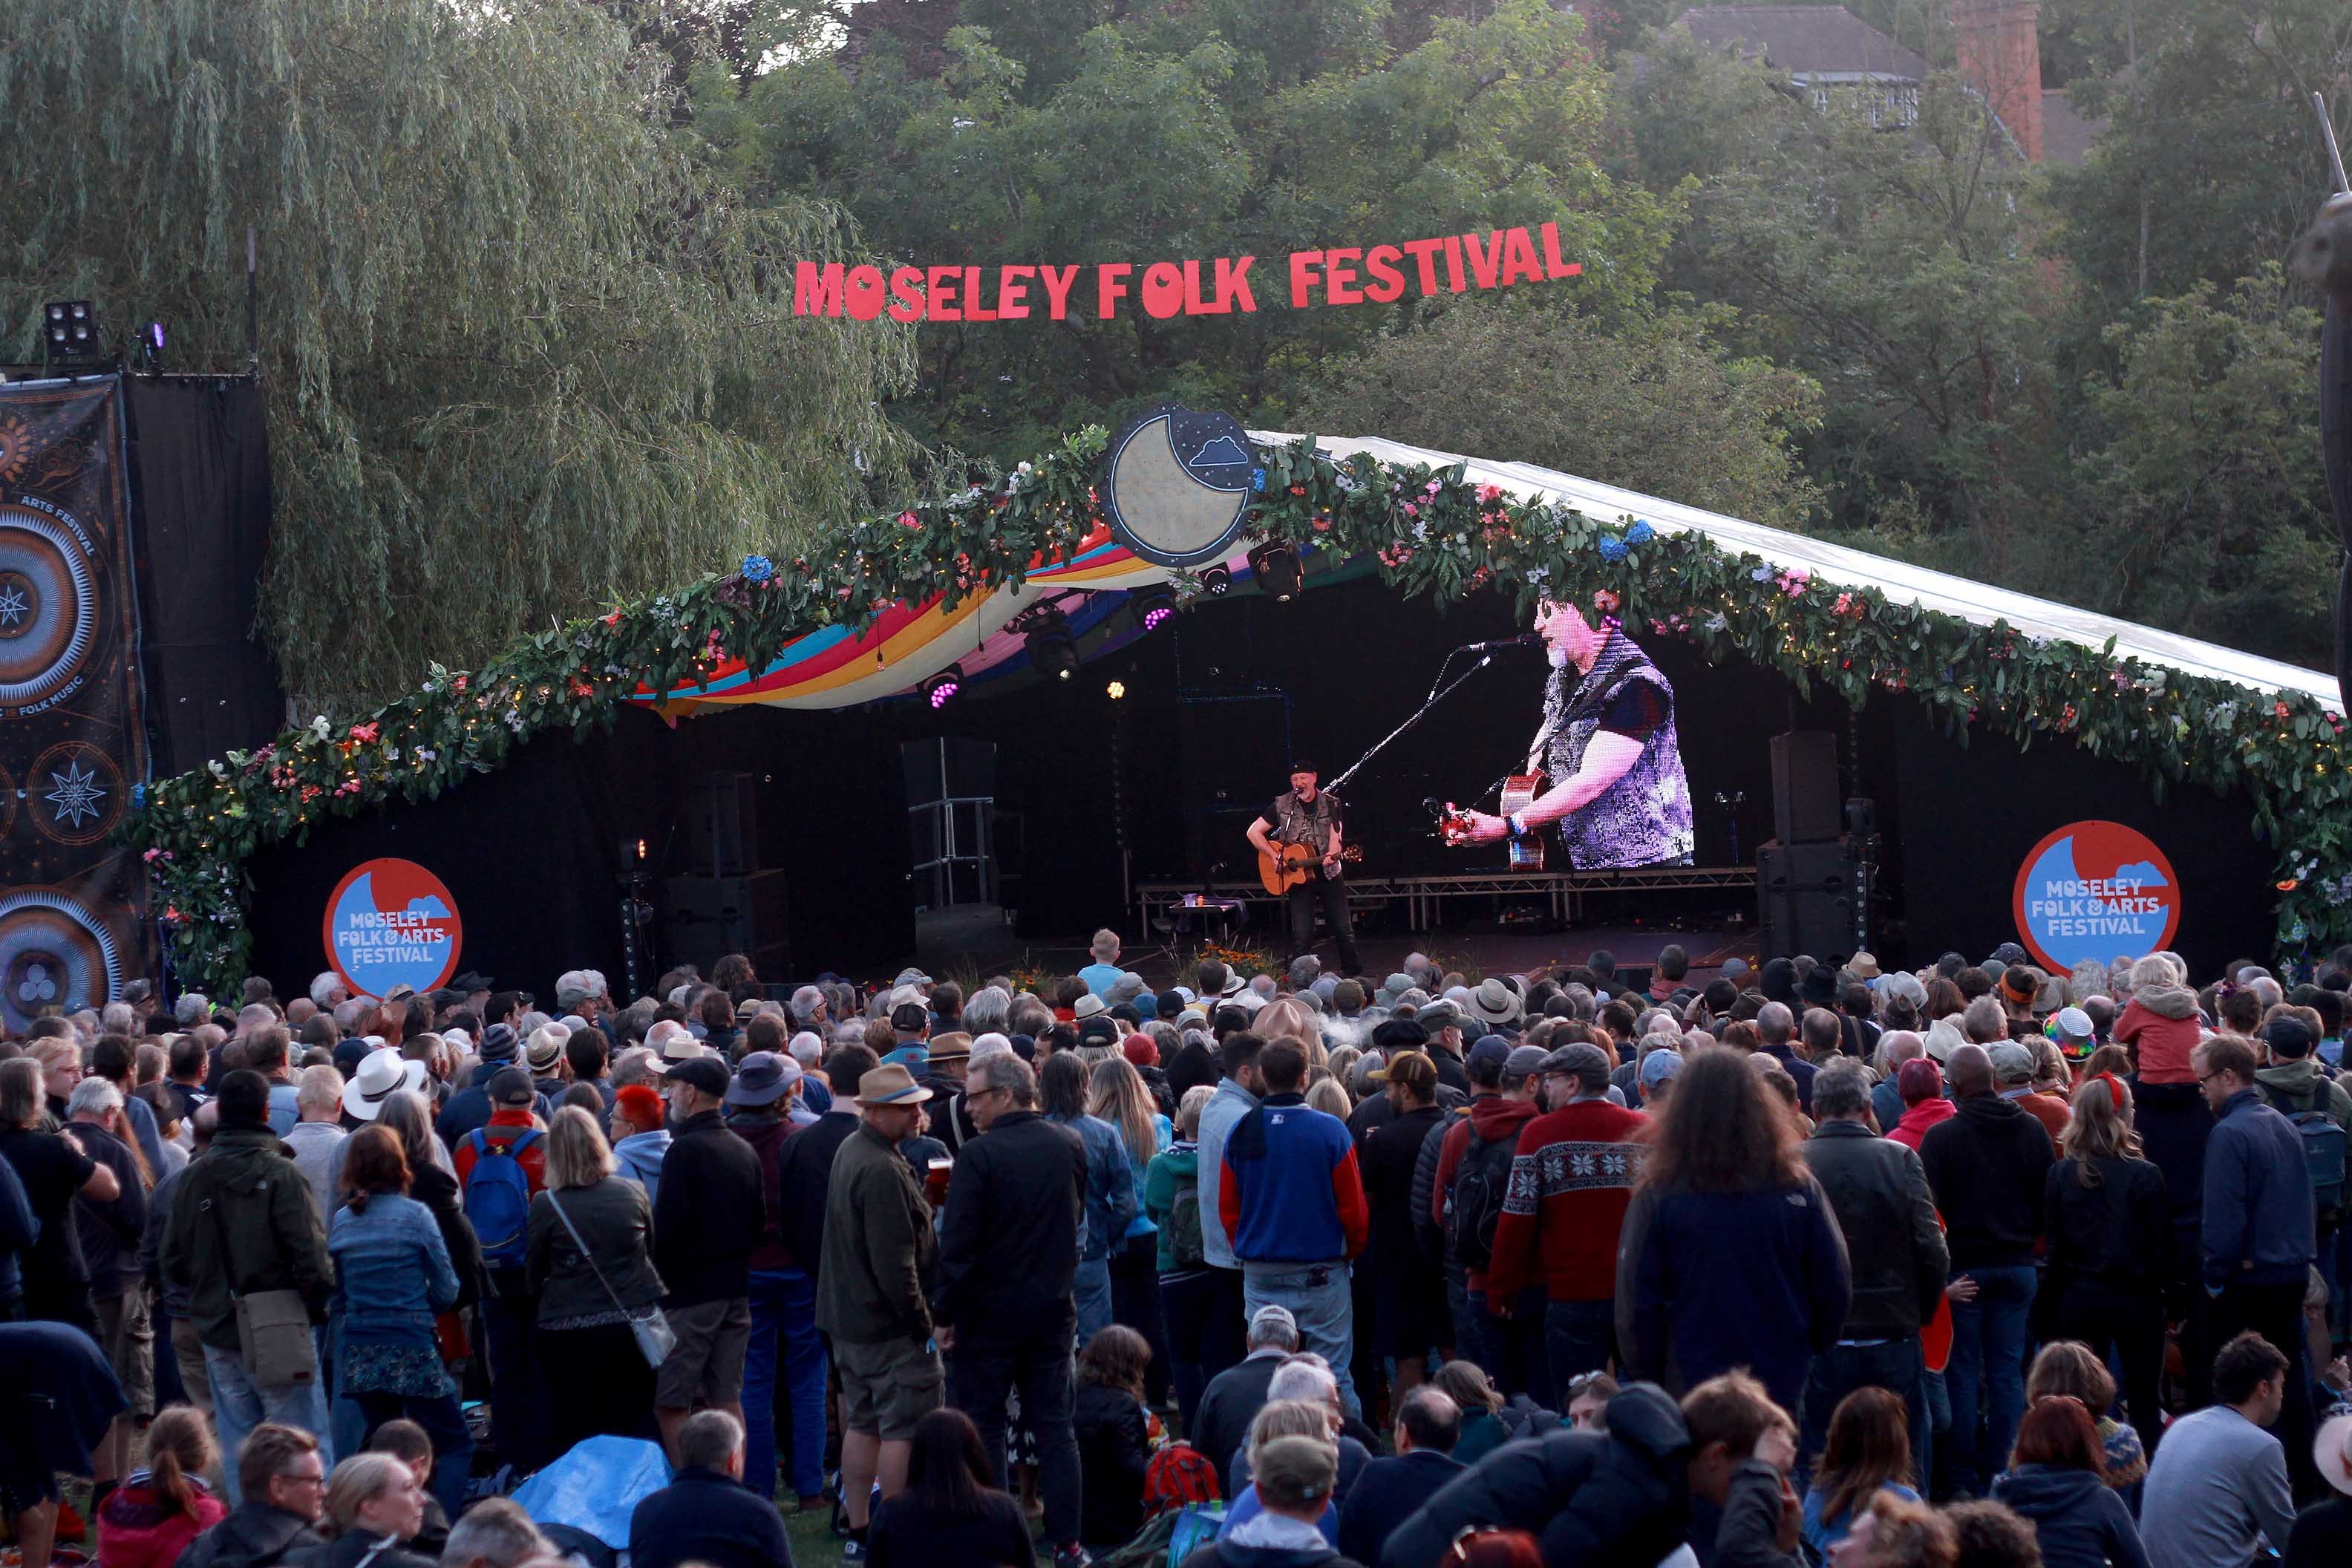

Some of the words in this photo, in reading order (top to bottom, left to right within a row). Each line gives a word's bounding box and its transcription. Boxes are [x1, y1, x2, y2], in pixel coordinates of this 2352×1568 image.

[794, 261, 1079, 322] MOSELEY
[1098, 255, 1257, 321] FOLK
[1290, 222, 1582, 308] FESTIVAL
[21, 495, 53, 512] ARTS
[55, 509, 96, 557] FESTIVAL
[19, 700, 50, 716] FOLK
[49, 676, 83, 705] MUSIC
[2046, 878, 2143, 898] MOSELEY
[2031, 899, 2085, 918] FOLK
[2087, 898, 2103, 916] &
[2106, 897, 2160, 915] ARTS
[350, 910, 430, 928] MOSELEY
[2048, 917, 2146, 937] FESTIVAL
[339, 930, 382, 947] FOLK
[384, 929, 398, 945] &
[401, 928, 445, 944] ARTS
[352, 947, 433, 964] FESTIVAL
